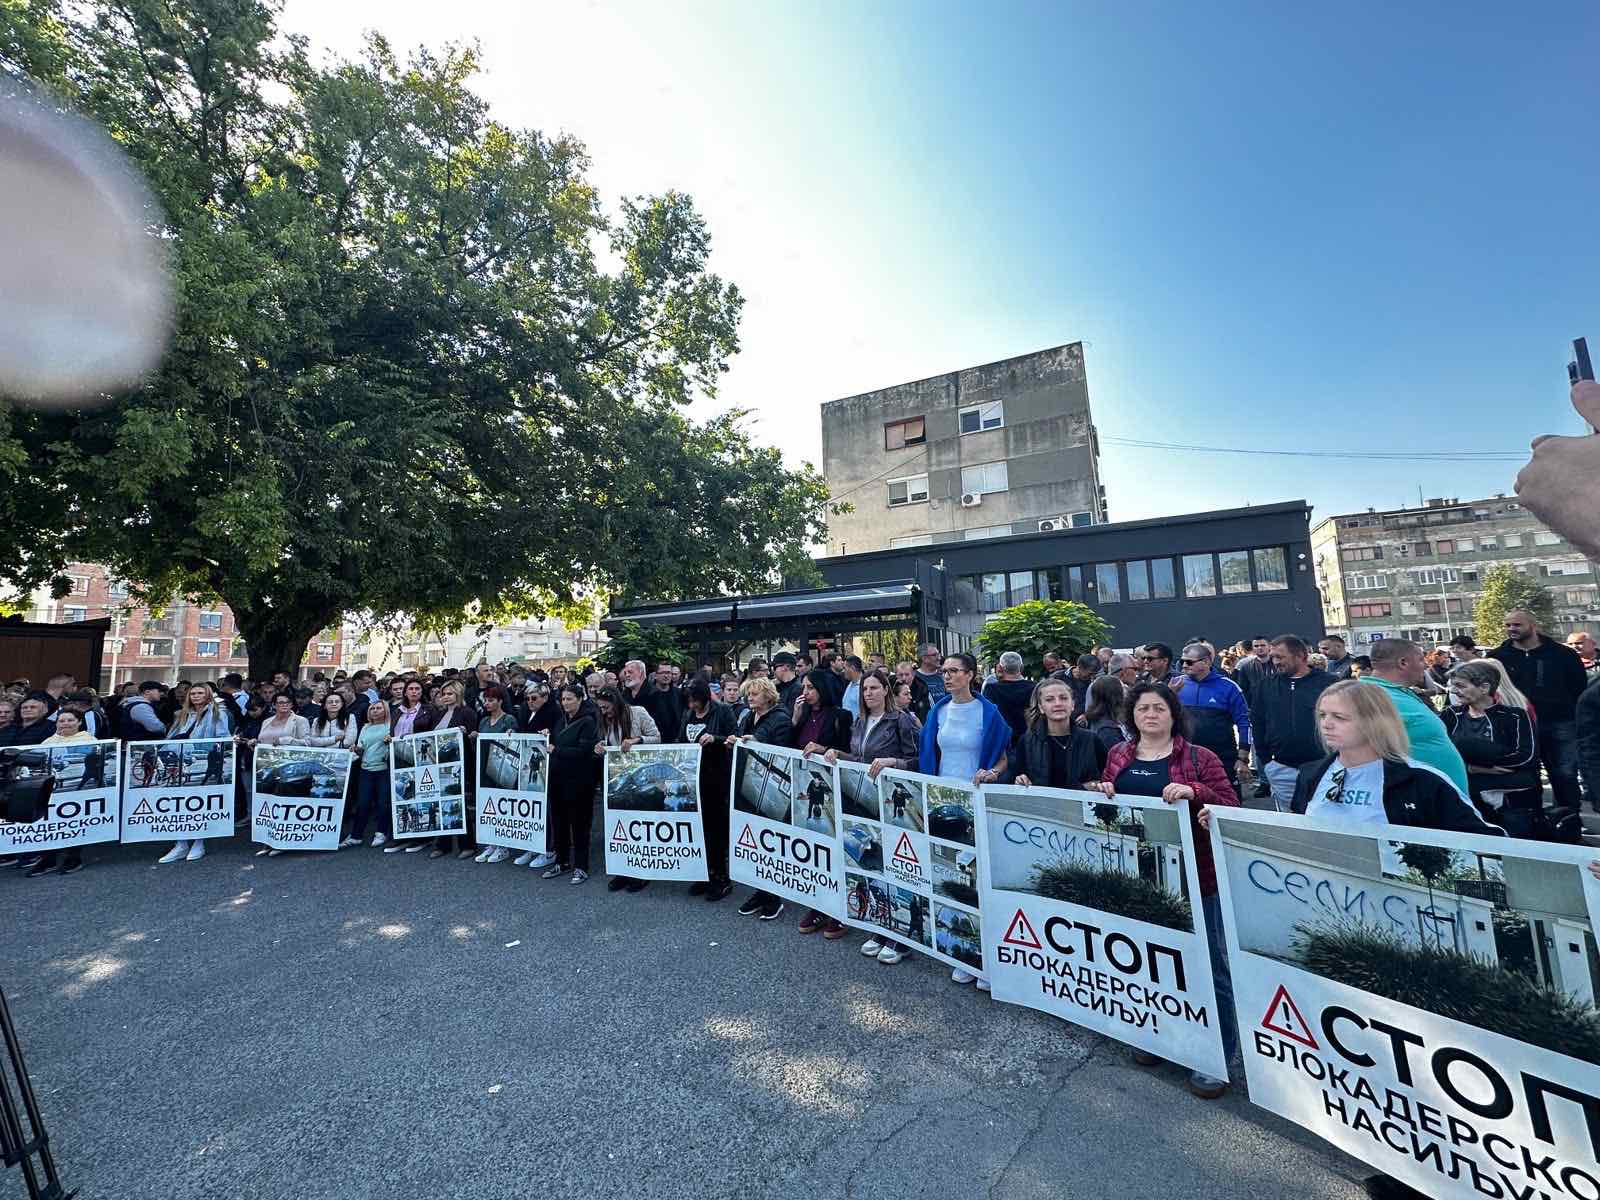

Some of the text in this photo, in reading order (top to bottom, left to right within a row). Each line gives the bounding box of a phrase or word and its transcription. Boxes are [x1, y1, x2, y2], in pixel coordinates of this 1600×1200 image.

[42, 798, 105, 820] ТОП
[156, 794, 224, 813] СТОП
[271, 803, 334, 821] СТОП
[497, 797, 542, 820] СТОП
[0, 816, 114, 836] ЛОКАДЕРСКОМ
[127, 812, 230, 826] БЛОКАДЕРСКОМ
[151, 822, 208, 833] НАСИЉУ!
[480, 816, 545, 833] БЛОКАДЕРСКОМ
[12, 828, 86, 845] НАСИЉУ!
[629, 820, 694, 843] СТОП
[609, 842, 702, 858] БЛОКАДЕРСКОМ
[759, 829, 831, 873] СТОП
[627, 856, 680, 870] НАСИЉУ!
[734, 846, 839, 893] БЛОКАДЕРСКОМ
[891, 858, 923, 876] СТОП
[755, 866, 816, 897] НАСИЉУ!
[1044, 916, 1188, 993] СТОП
[998, 945, 1209, 1028] БЛОКАДЕРСКОМ
[1041, 976, 1159, 1034] НАСИЉУ!
[1320, 1006, 1600, 1163] СТОП
[1254, 1031, 1600, 1200] БЛОКАДЕРСКО
